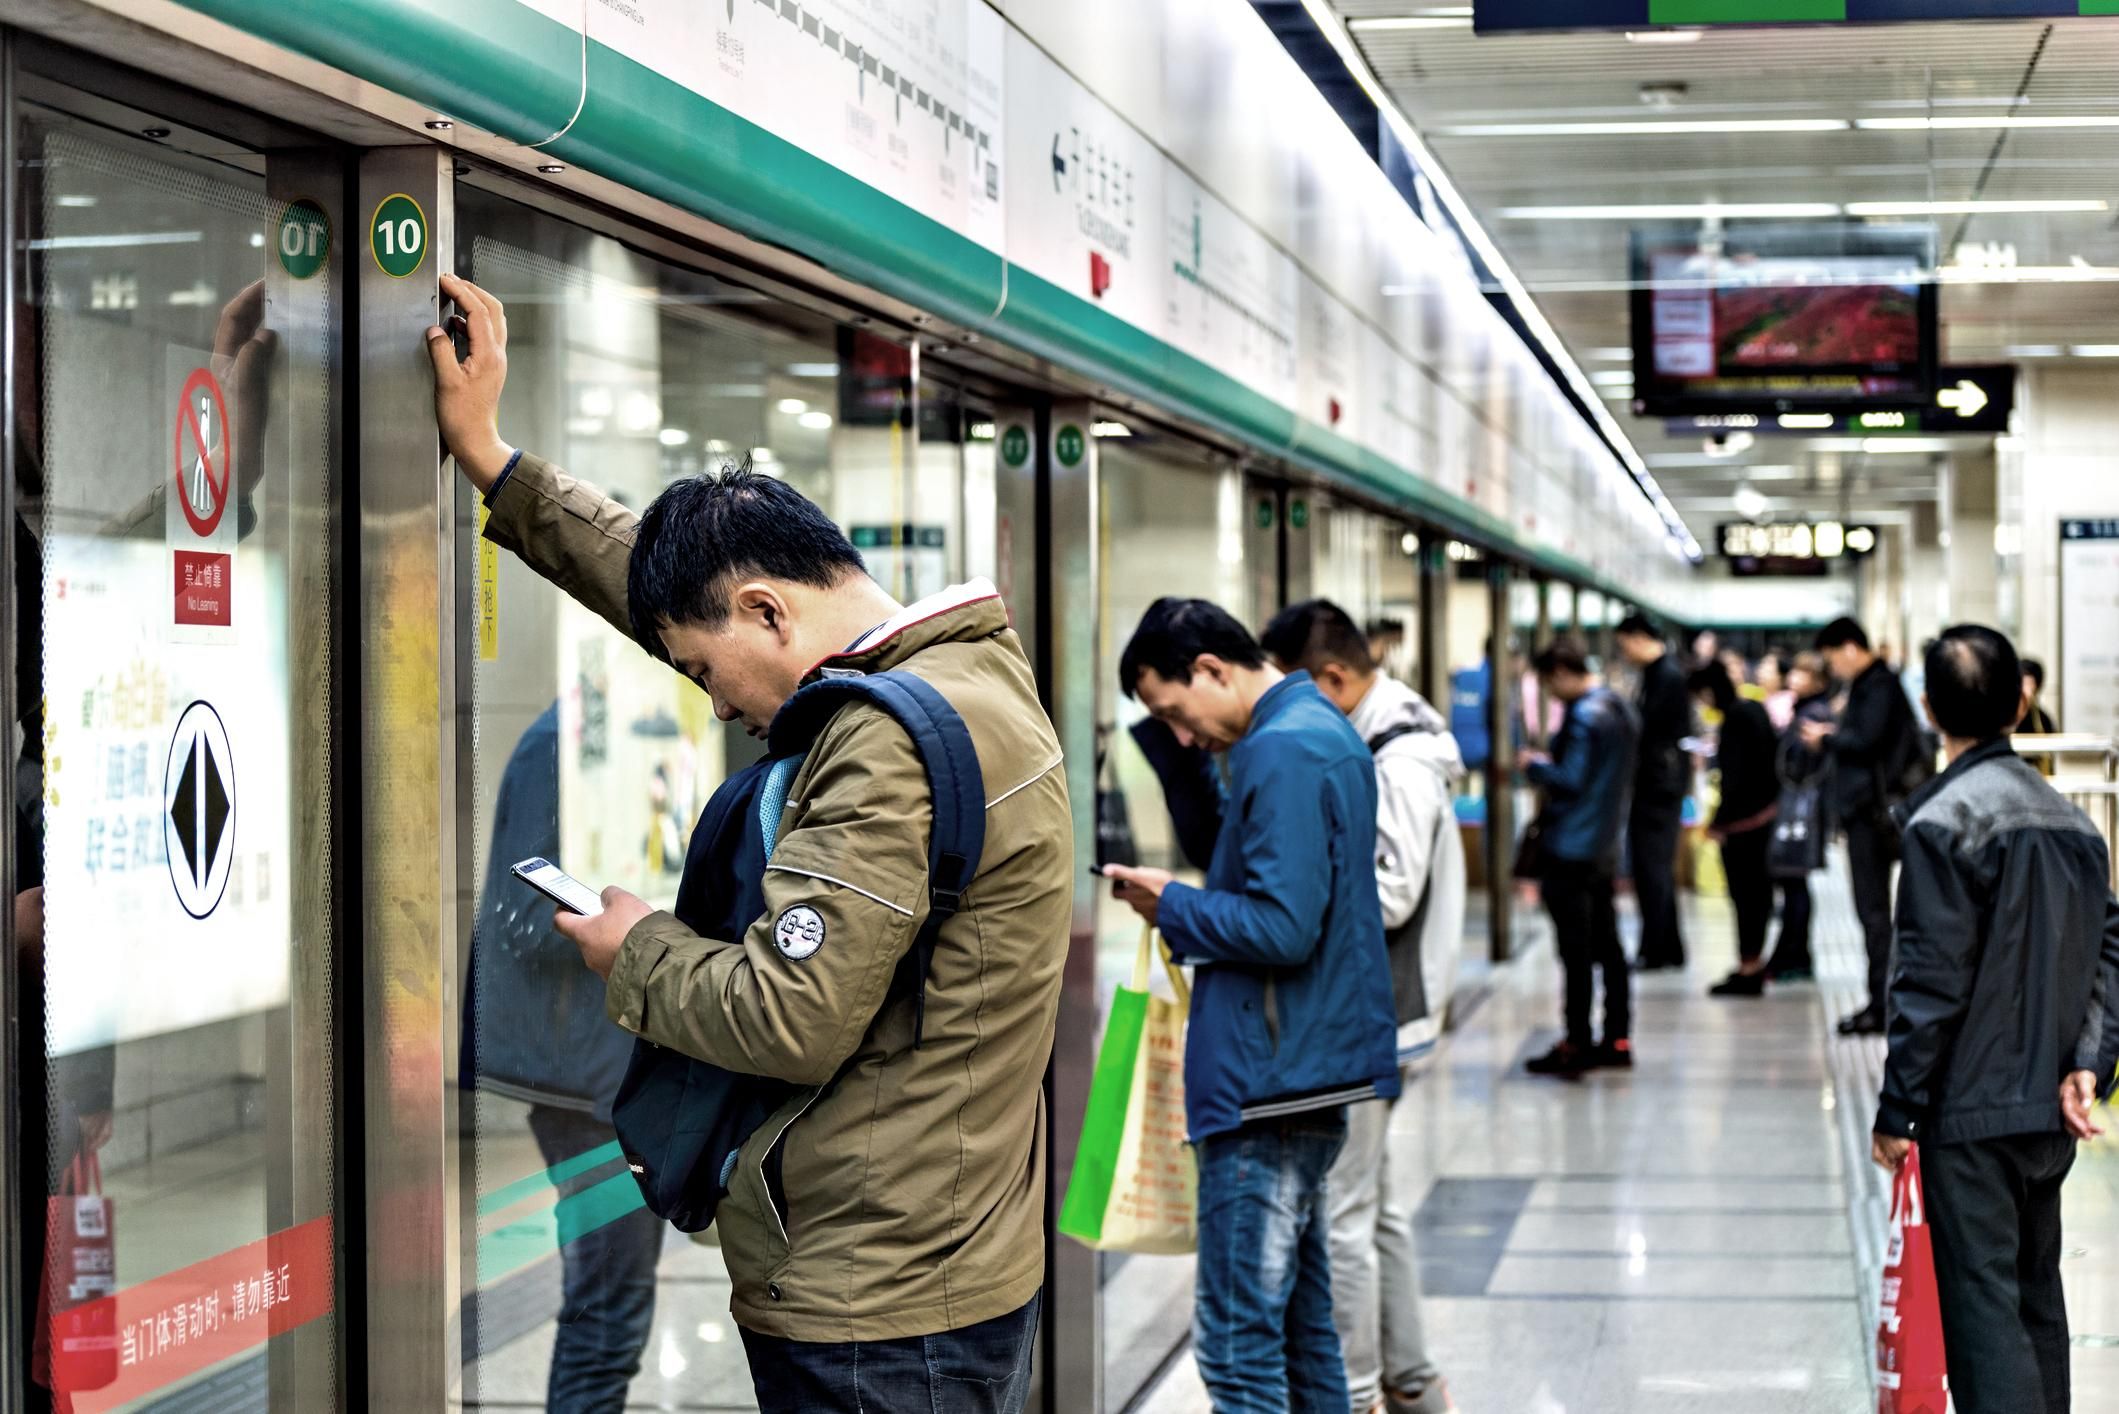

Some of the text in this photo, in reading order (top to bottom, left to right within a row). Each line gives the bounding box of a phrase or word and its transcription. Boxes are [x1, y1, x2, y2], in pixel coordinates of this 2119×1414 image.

[378, 218, 422, 255] 10
[184, 561, 222, 588] 禁止倚靠
[187, 595, 219, 616] No Leaning
[122, 1263, 291, 1367] 当门体滑动时，请勿靠近
